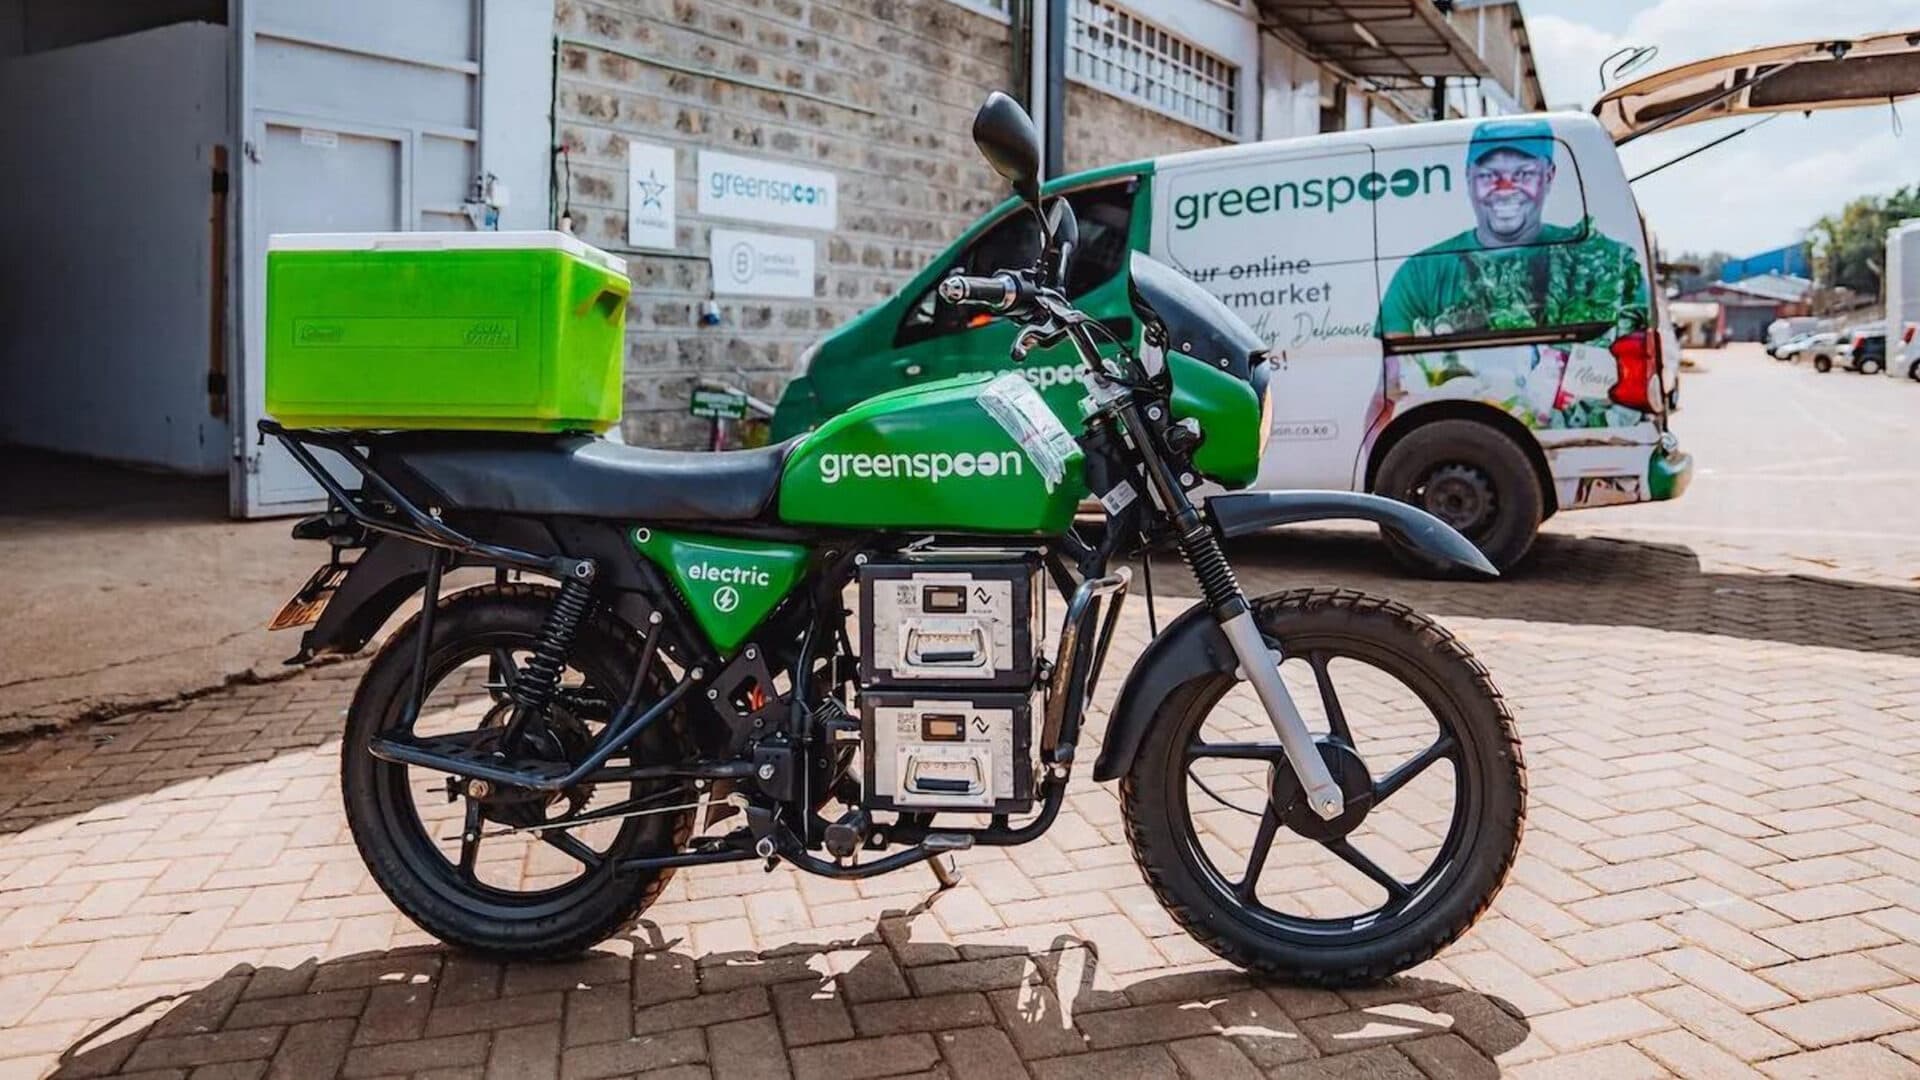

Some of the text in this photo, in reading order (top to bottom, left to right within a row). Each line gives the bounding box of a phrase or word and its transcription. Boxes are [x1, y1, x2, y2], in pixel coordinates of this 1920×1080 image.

[710, 168, 828, 208] greenspoon
[1174, 162, 1452, 231] greenspoon
[1229, 255, 1312, 280] online
[1215, 282, 1332, 308] rmarket
[1290, 307, 1371, 348] Delicious
[819, 450, 1022, 484] greenspoon
[688, 561, 769, 586] electric
